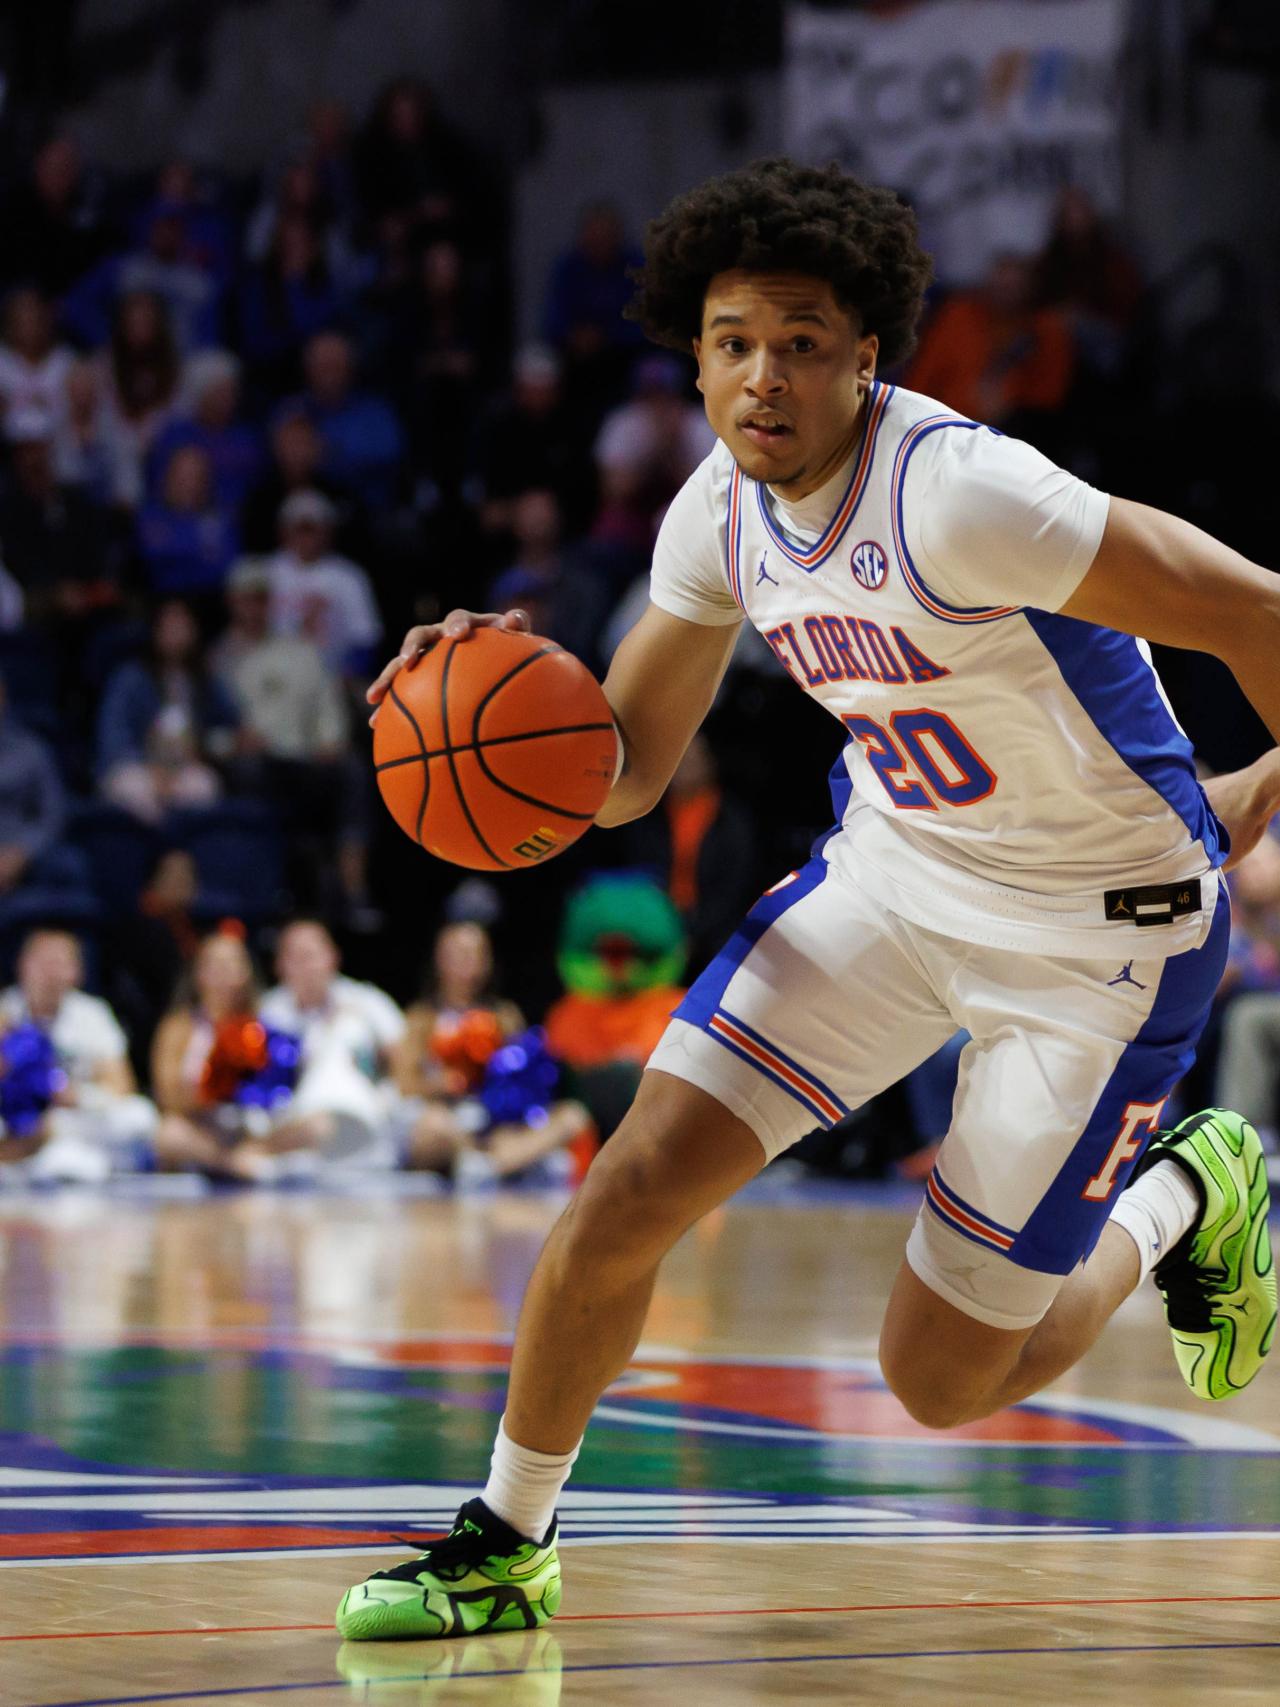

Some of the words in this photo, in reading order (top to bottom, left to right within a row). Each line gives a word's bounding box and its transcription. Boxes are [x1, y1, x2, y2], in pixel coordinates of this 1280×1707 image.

[852, 543, 886, 589] SEC
[763, 614, 952, 690] FLORIDA
[841, 707, 998, 811] 20
[1177, 891, 1190, 905] 46
[1080, 1094, 1169, 1202] F
